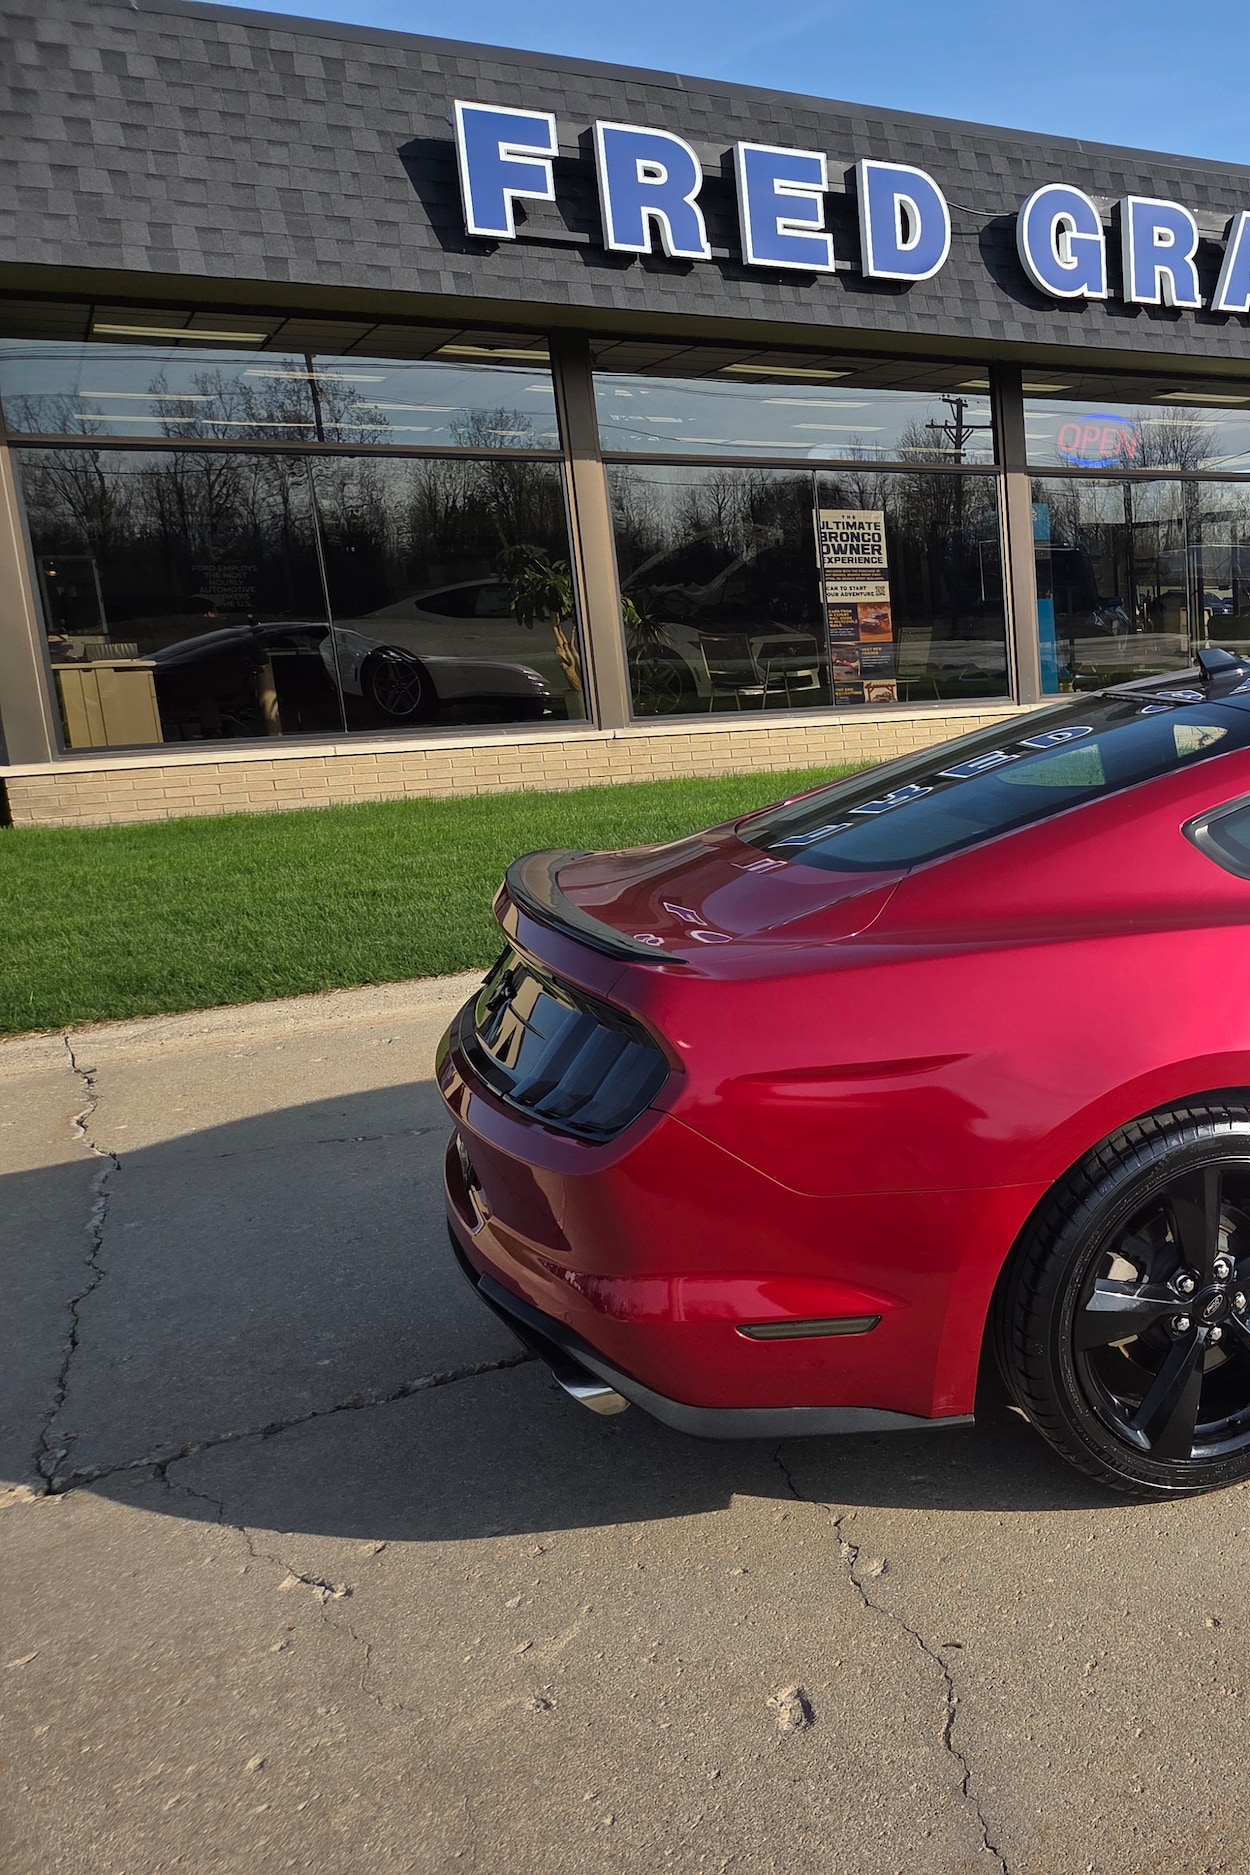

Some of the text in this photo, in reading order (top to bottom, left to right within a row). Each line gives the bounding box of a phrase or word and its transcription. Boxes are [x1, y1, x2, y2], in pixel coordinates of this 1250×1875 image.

[453, 99, 952, 282] FRED
[1058, 422, 1138, 459] OPEN
[820, 532, 882, 543] BRONCO
[822, 543, 883, 555] OWNER
